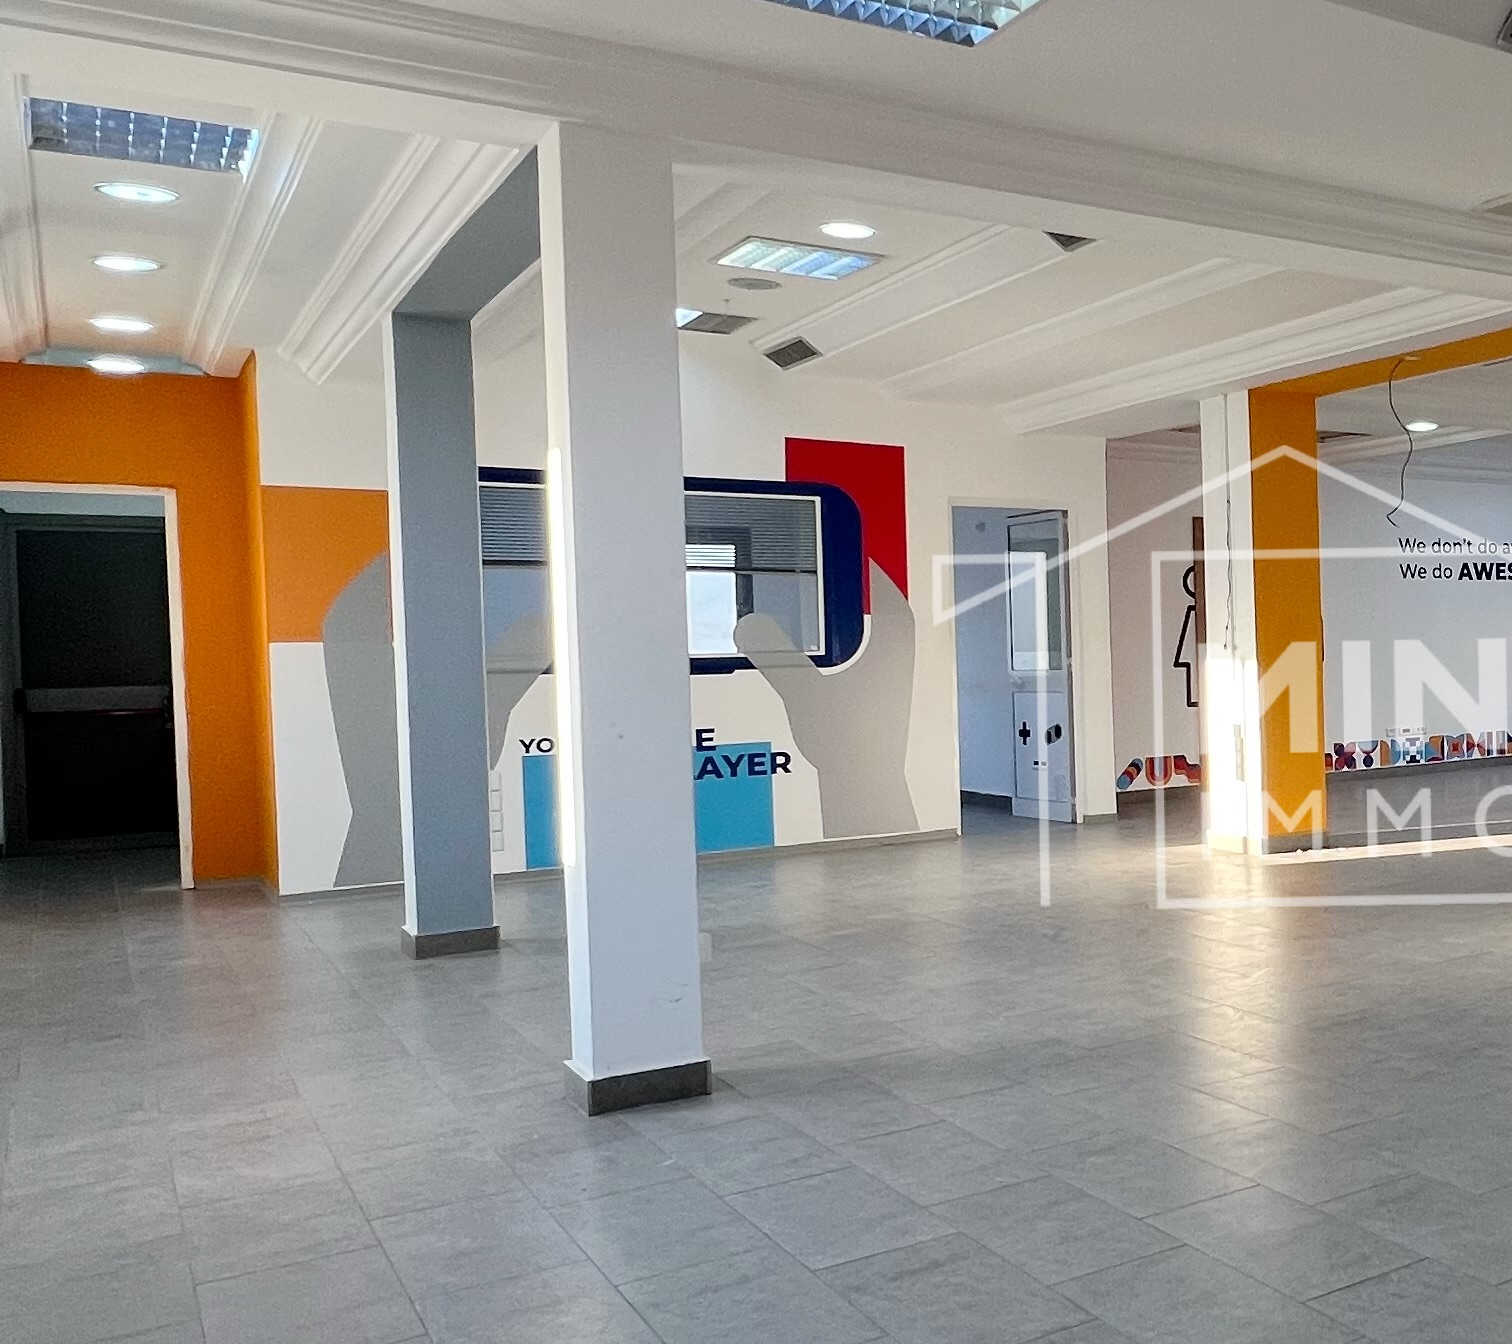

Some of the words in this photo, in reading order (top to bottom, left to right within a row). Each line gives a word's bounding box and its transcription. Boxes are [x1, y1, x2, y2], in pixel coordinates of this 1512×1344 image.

[1398, 537, 1426, 554] We
[1431, 537, 1473, 554] don't
[1477, 537, 1497, 554] do
[1399, 563, 1427, 579] We
[1432, 562, 1453, 579] do
[519, 738, 554, 754] YO
[695, 728, 716, 752] E
[693, 751, 792, 781] AYER
